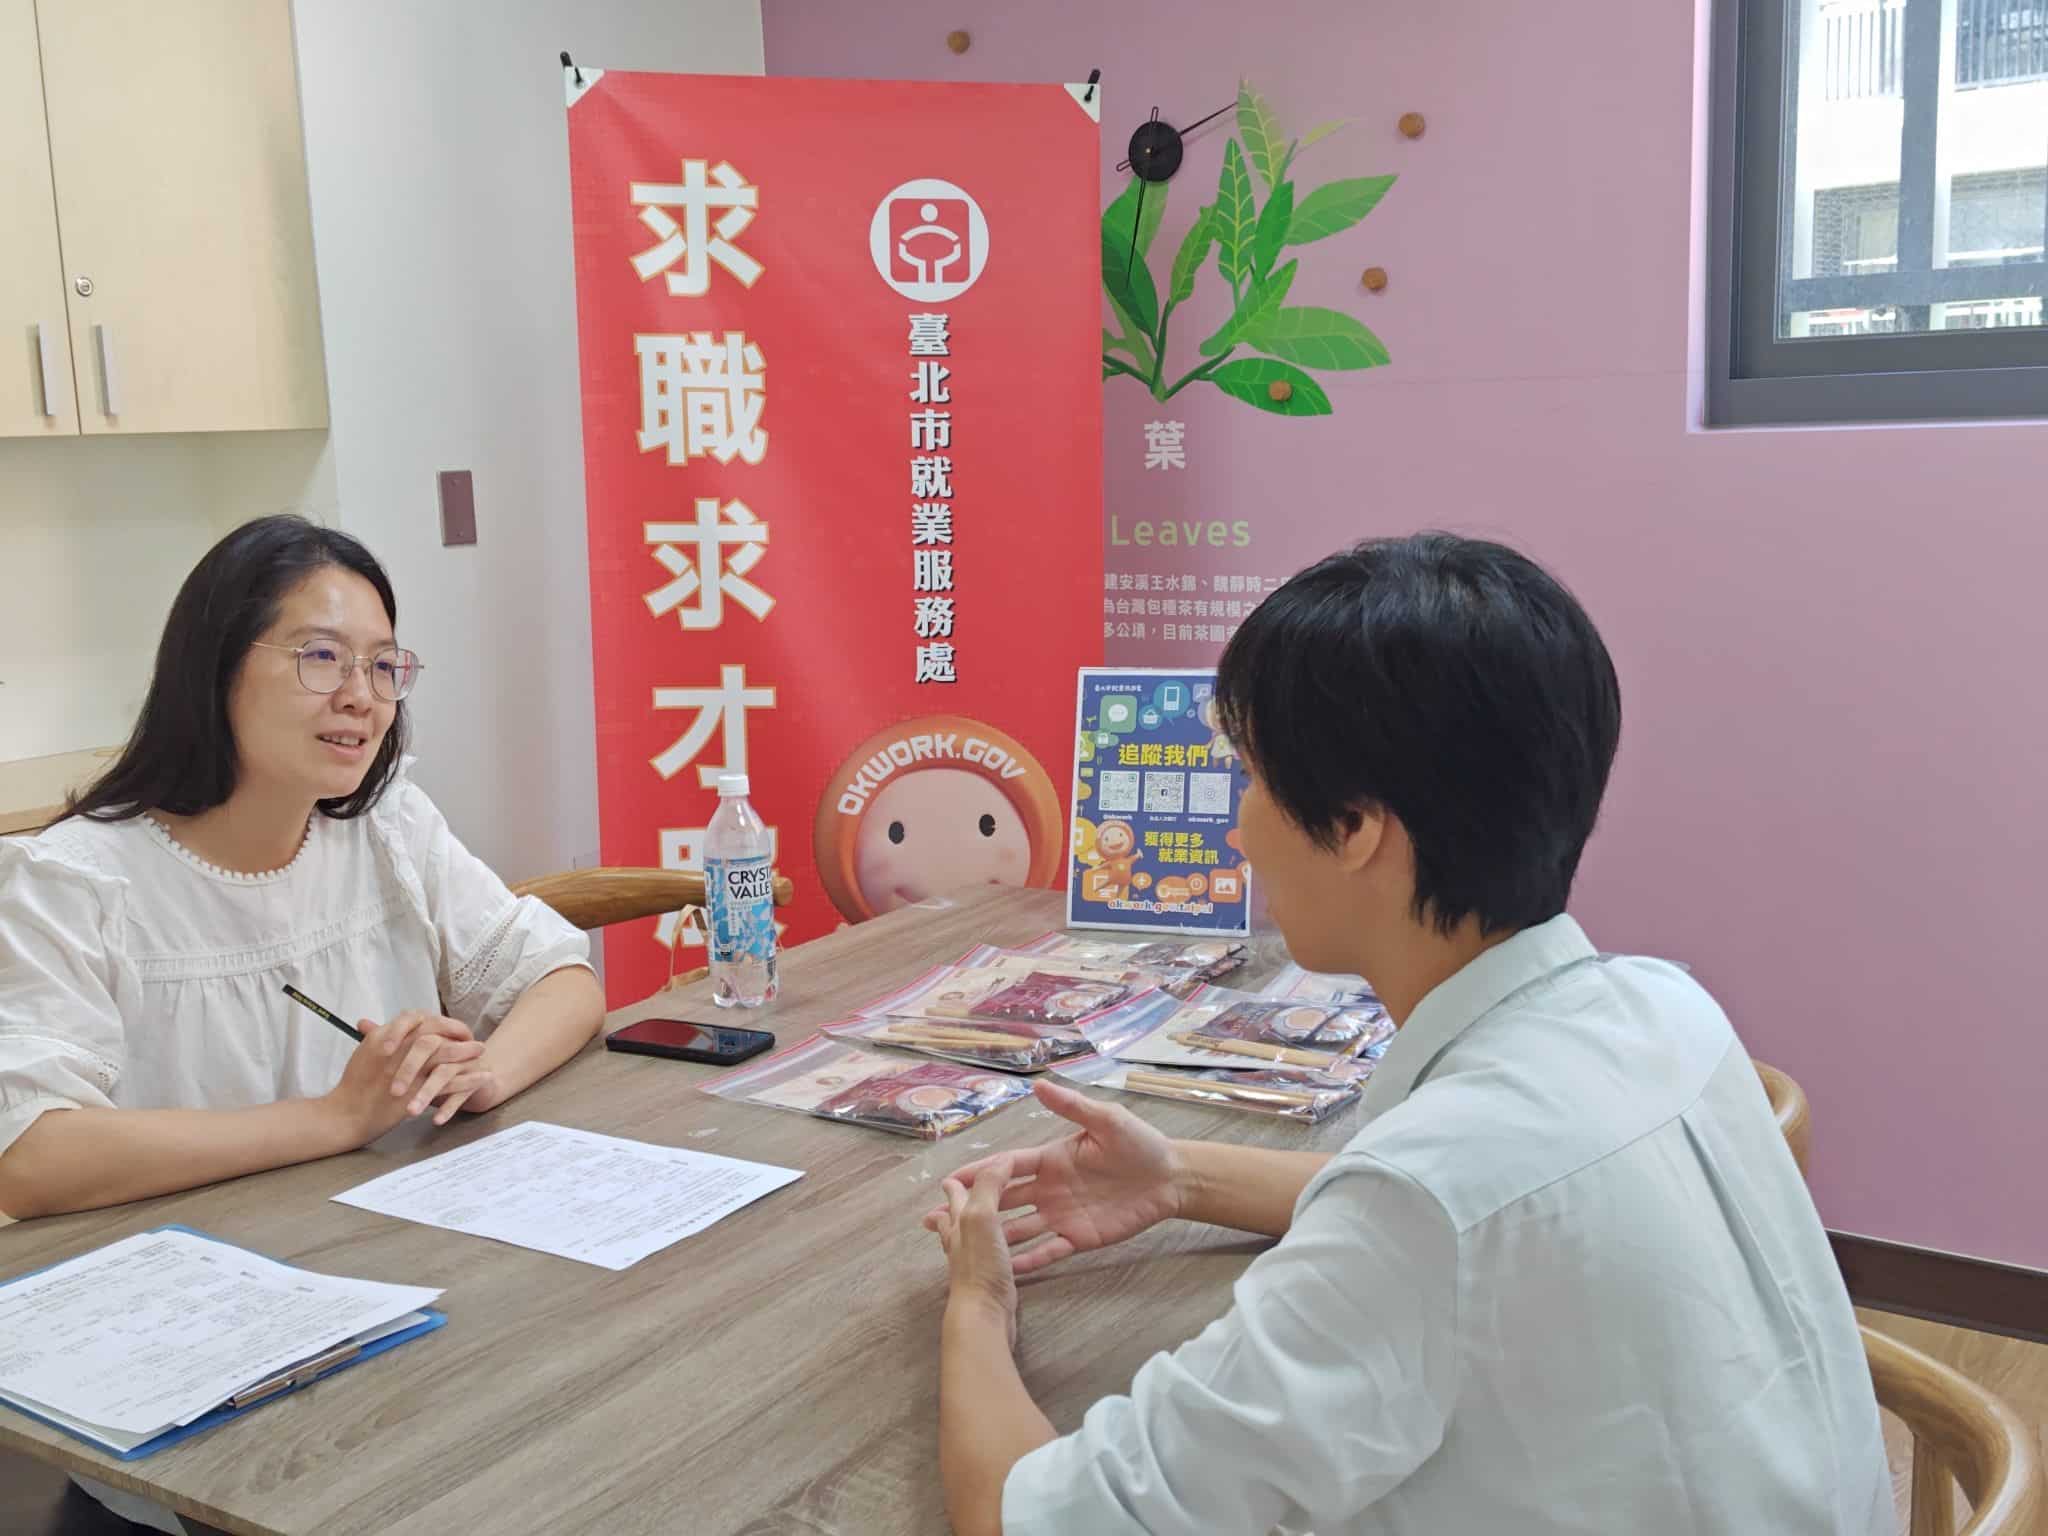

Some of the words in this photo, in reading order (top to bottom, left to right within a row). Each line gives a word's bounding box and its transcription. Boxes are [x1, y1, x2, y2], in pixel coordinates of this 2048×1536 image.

[1144, 420, 1186, 470] 葉
[908, 313, 957, 685] 臺北市就業服務處
[1111, 514, 1250, 547] Leaves
[1118, 743, 1209, 768] 追蹤我們
[837, 733, 1027, 816] OKWORK.GOV
[1144, 831, 1204, 847] 獲得更多
[1158, 848, 1219, 864] 就業資訊
